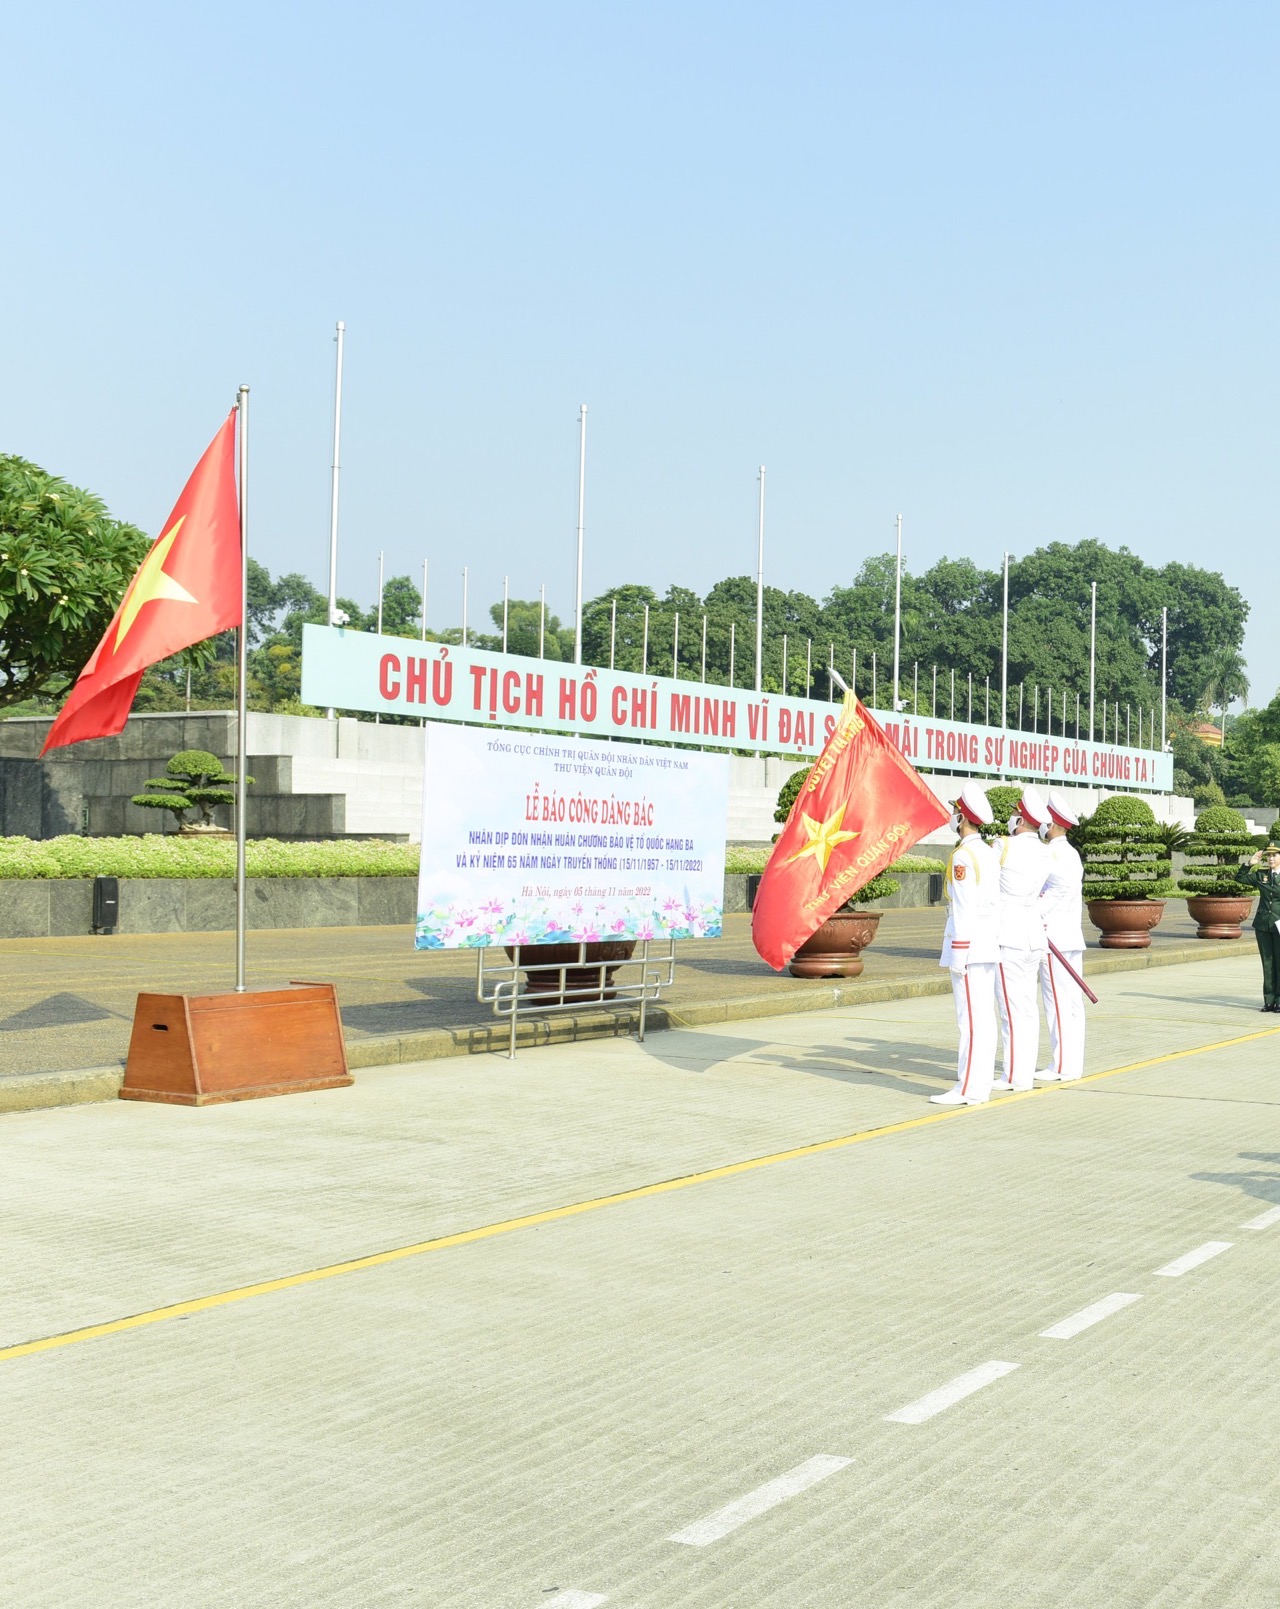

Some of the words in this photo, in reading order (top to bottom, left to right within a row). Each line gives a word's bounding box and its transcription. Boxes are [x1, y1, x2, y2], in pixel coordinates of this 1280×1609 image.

[379, 647, 453, 706] CHỦ
[470, 665, 543, 720] TỊCH
[559, 669, 598, 722] HỒ
[611, 681, 657, 730] CHÍ
[671, 693, 736, 738] MINH
[747, 698, 770, 741] VĨ
[778, 707, 814, 752] ĐẠI
[926, 728, 979, 764] TRONG
[985, 734, 1005, 771] SỰ
[1009, 739, 1059, 776] NGHIỆP
[1063, 741, 1087, 776] CỦA
[1092, 748, 1130, 779] CHÚNG
[1135, 757, 1148, 781] TA
[487, 738, 512, 753] TỔNG
[514, 744, 532, 756] CỤC
[533, 745, 561, 758] CHÍNH
[562, 749, 576, 761] TRỊ
[577, 750, 600, 761] QUÂN
[601, 752, 615, 764] ĐỘI
[617, 753, 638, 765] NHÂN
[639, 755, 654, 766] DÂN
[655, 757, 672, 769] VIỆT
[673, 760, 689, 770] NAM
[554, 762, 573, 773] THƯ
[573, 763, 593, 776] VIỆN
[595, 765, 617, 777] QUÂN
[619, 767, 633, 780] ĐỘI
[525, 781, 540, 821] LỄ
[542, 789, 566, 822] BÁO
[568, 790, 599, 824] CÔNG
[600, 793, 631, 825] DÂNG
[633, 795, 654, 826] BÁC
[469, 828, 493, 845] NHÂN
[495, 831, 509, 848] DỊP
[511, 829, 528, 846] ĐÓN
[530, 830, 553, 849] NHẬN
[555, 831, 576, 847] HUÂN
[577, 833, 608, 848] CHƯƠNG
[609, 832, 623, 848] BẢO
[625, 834, 634, 851] VỆ
[636, 832, 645, 849] TỔ
[646, 833, 664, 851] QUỐC
[665, 838, 683, 853] HẠNG
[685, 839, 694, 851] BA
[456, 851, 467, 868] VÀ
[483, 852, 505, 871] NIỆM
[507, 855, 517, 868] 65
[519, 853, 538, 869] NĂM
[540, 853, 562, 869] NGÀY
[594, 853, 617, 870] THỐNG
[619, 858, 660, 871] (15/11/1957
[666, 859, 703, 872] 15/11/2022)
[574, 886, 583, 897] 05
[608, 886, 616, 896] 11
[618, 887, 634, 897] năm
[635, 886, 651, 897] 2022
